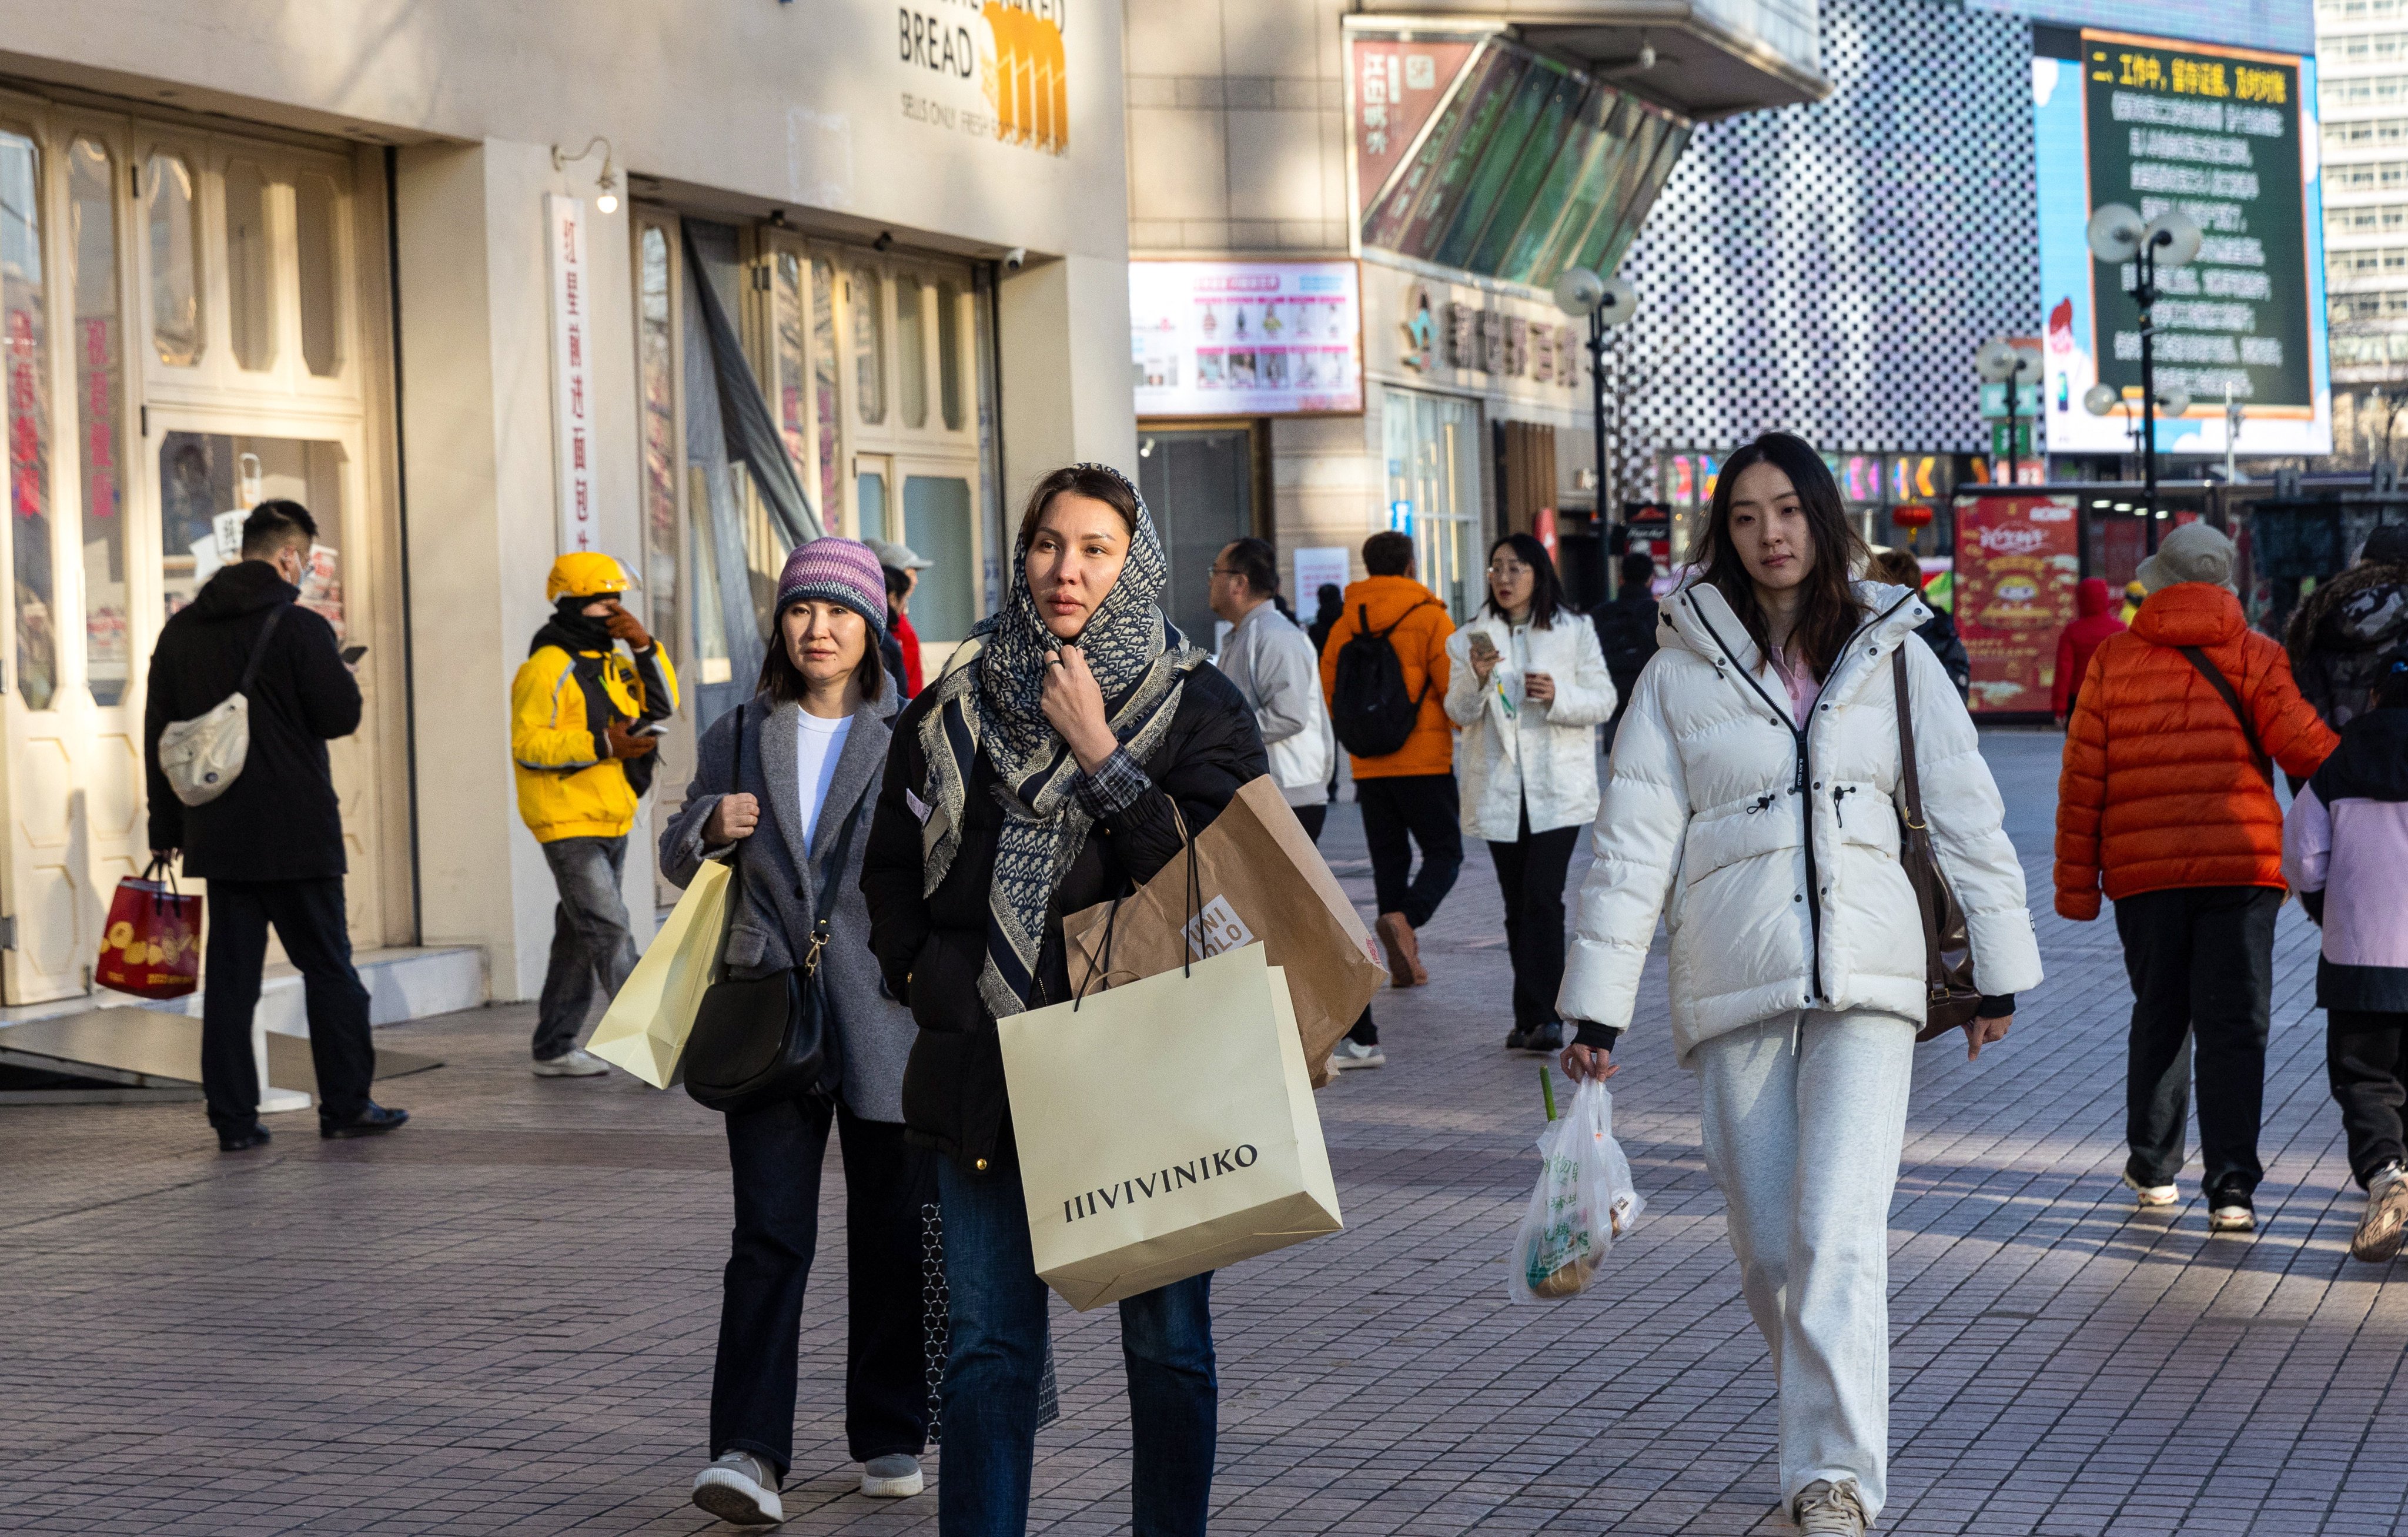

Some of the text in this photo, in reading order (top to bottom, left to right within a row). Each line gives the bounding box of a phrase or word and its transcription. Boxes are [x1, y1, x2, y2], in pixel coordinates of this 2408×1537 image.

[899, 7, 973, 79] BREAD
[1189, 906, 1227, 943] UNI
[1063, 1144, 1257, 1223] IIIVIVINIKO
